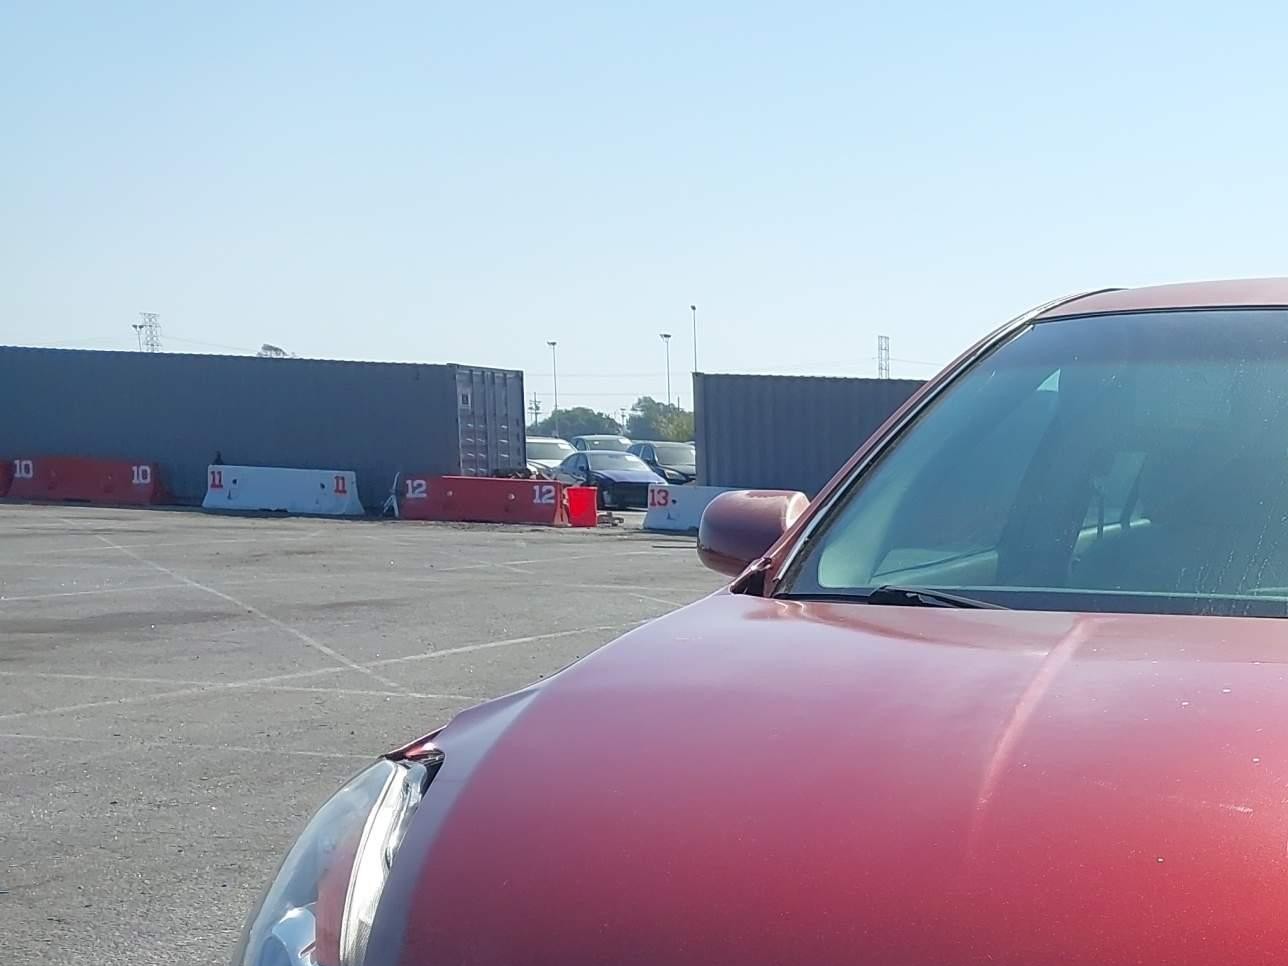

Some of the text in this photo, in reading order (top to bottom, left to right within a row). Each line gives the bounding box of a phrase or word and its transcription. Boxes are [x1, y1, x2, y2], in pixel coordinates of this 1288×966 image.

[14, 459, 33, 478] 10
[131, 465, 151, 484] 10
[210, 470, 223, 489] 11
[334, 475, 347, 494] 11
[406, 479, 427, 498] 12
[532, 485, 555, 504] 12
[649, 488, 669, 507] 13
